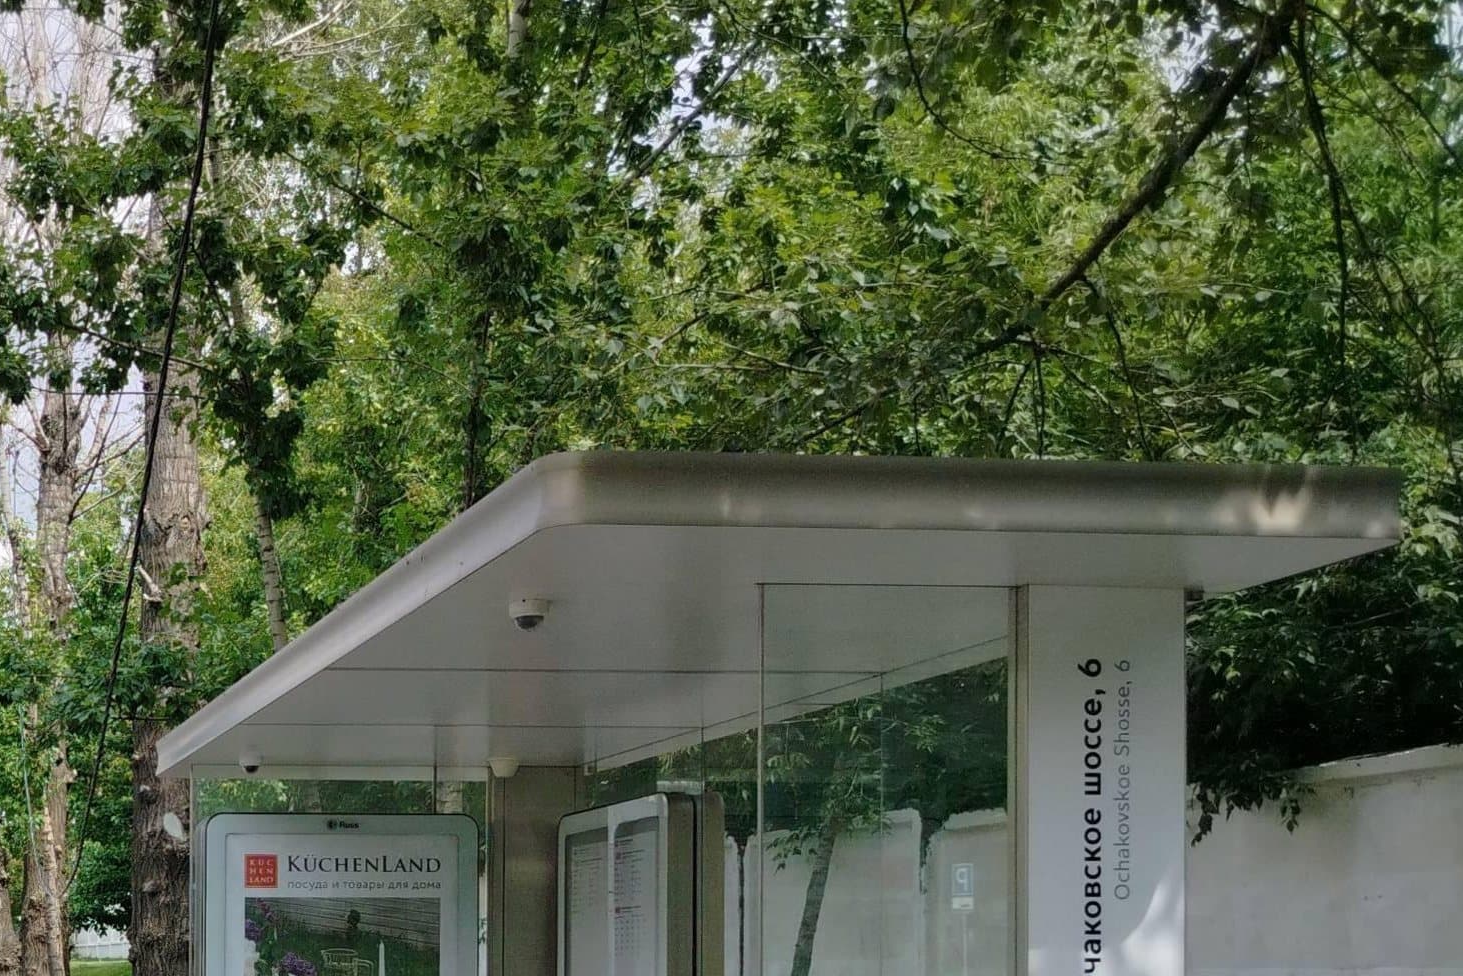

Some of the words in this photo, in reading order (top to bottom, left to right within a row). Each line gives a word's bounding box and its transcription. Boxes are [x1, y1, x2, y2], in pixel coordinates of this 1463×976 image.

[1077, 657, 1102, 679] 6
[1114, 659, 1131, 672] 6
[1083, 688, 1107, 796] шоссе,
[1113, 679, 1132, 757] Shosse,
[1113, 763, 1131, 900] Ochakovskoe
[287, 880, 328, 890] посуда
[332, 880, 340, 889] и
[343, 880, 385, 890] товары
[388, 880, 410, 890] для
[412, 880, 442, 890] дома
